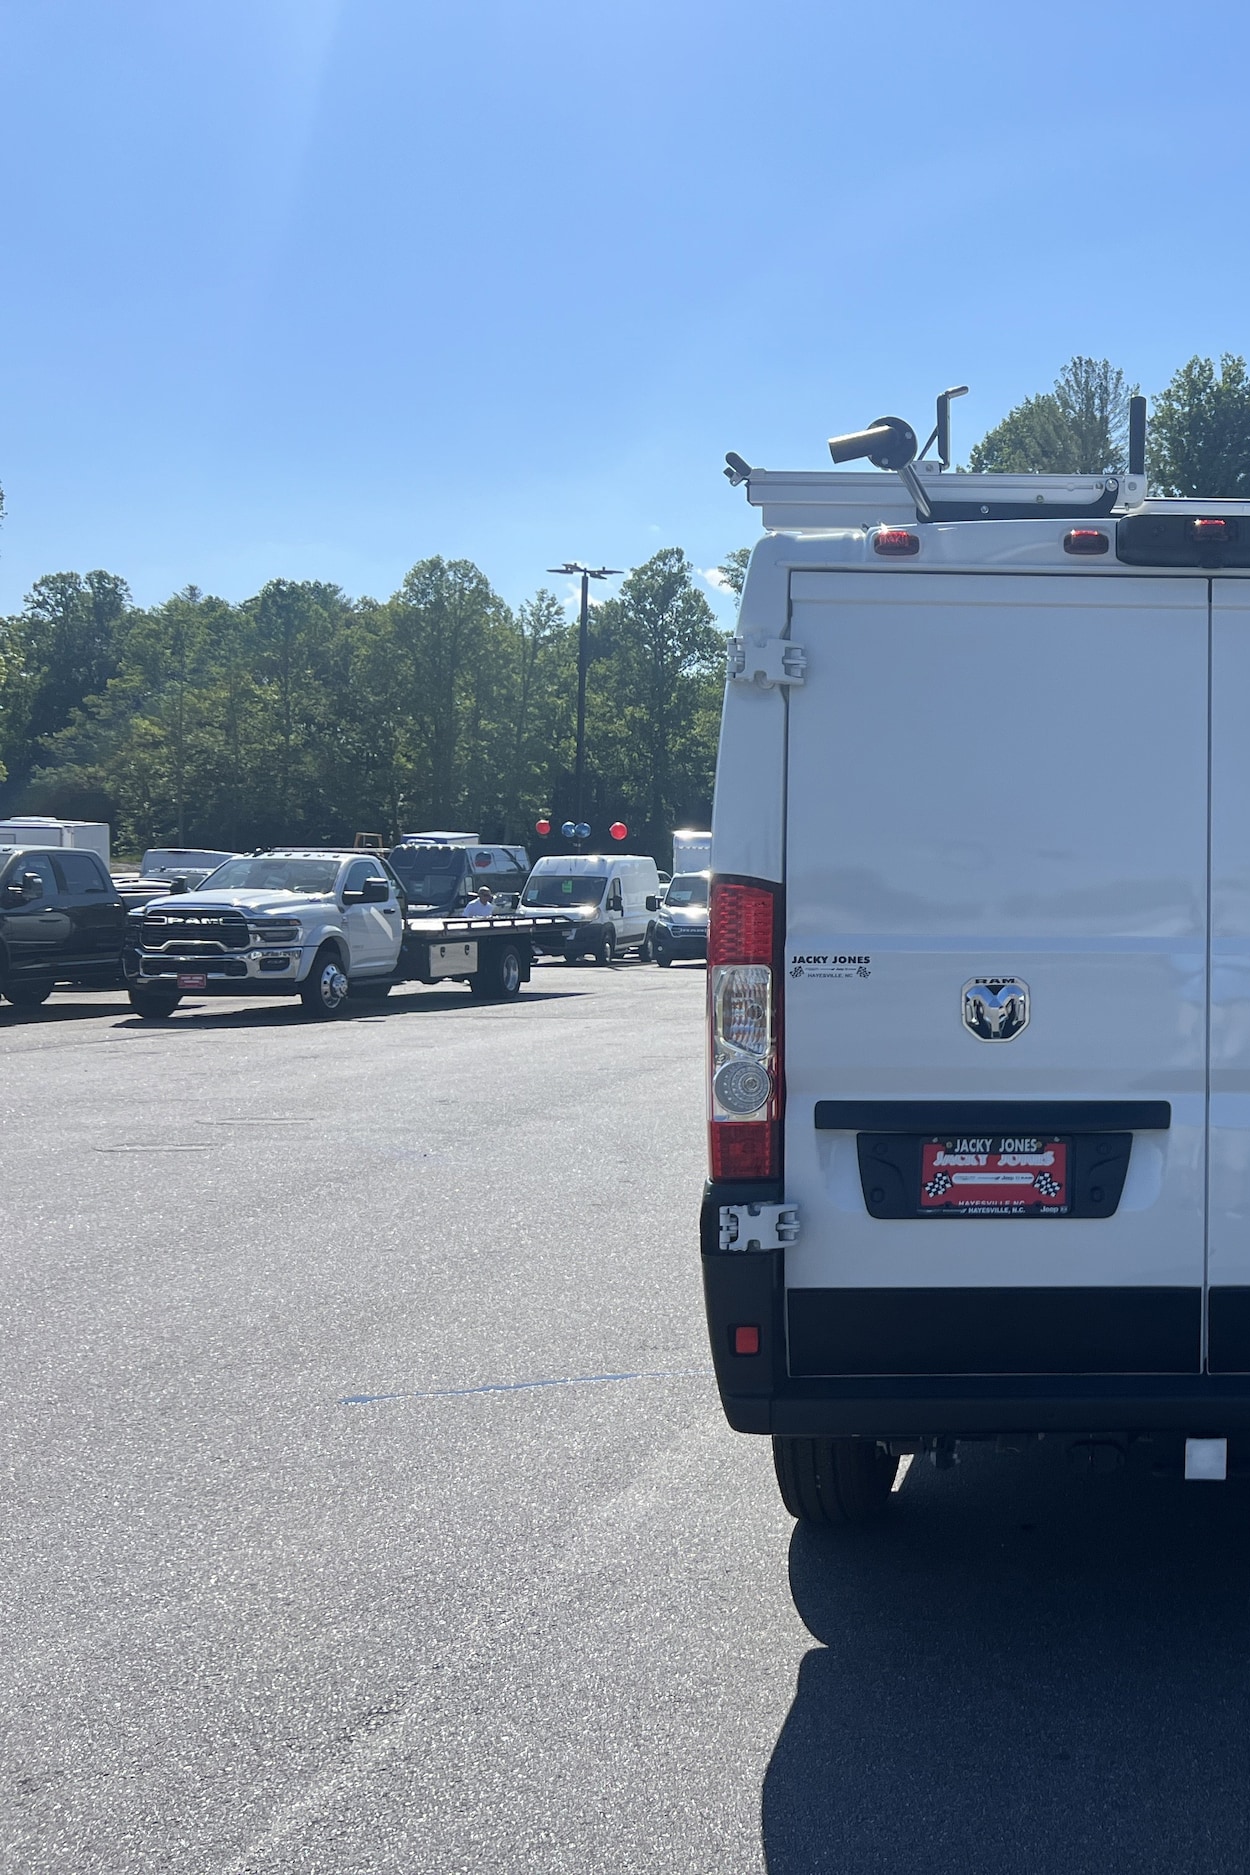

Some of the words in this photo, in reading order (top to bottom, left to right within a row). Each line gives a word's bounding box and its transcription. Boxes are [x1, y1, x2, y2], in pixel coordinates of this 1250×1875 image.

[792, 955, 828, 964] JACKY
[832, 955, 871, 964] JONES
[954, 1138, 993, 1153] JACKY
[999, 1138, 1037, 1153] JONES
[933, 1151, 988, 1167] JACKY
[998, 1151, 1055, 1167] JONES
[968, 1206, 1011, 1214] HAYESVILLE,
[1012, 1206, 1026, 1214] N.C.
[1040, 1205, 1059, 1213] Jeep
